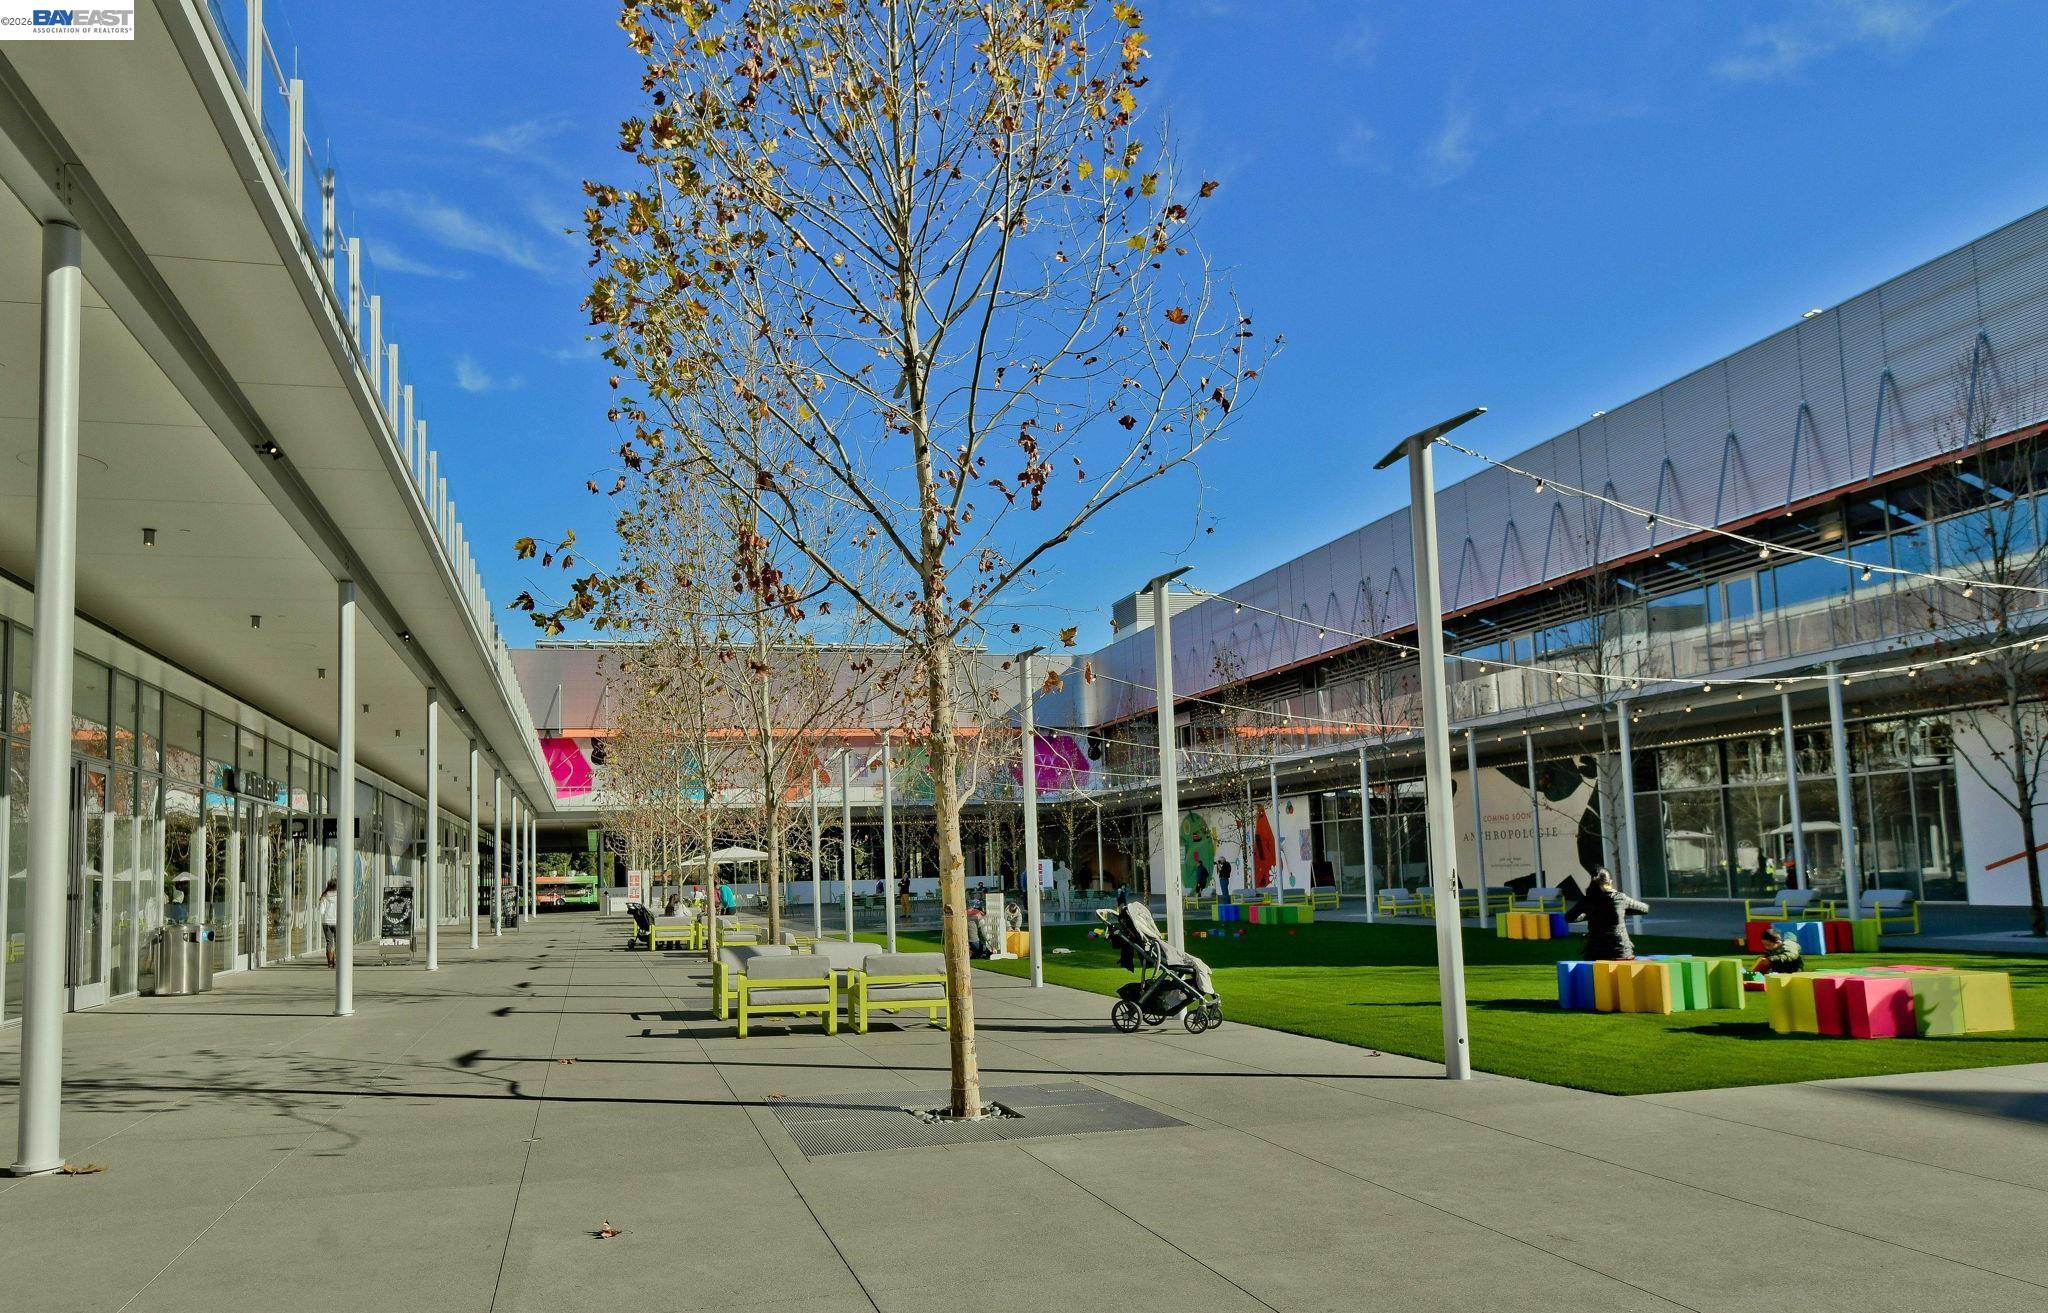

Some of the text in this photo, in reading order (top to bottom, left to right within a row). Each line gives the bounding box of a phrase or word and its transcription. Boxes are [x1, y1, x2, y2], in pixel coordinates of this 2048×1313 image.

[1483, 812, 1532, 823] COMING SOON
[1463, 826, 1559, 842] ANHROPOLOGIE
